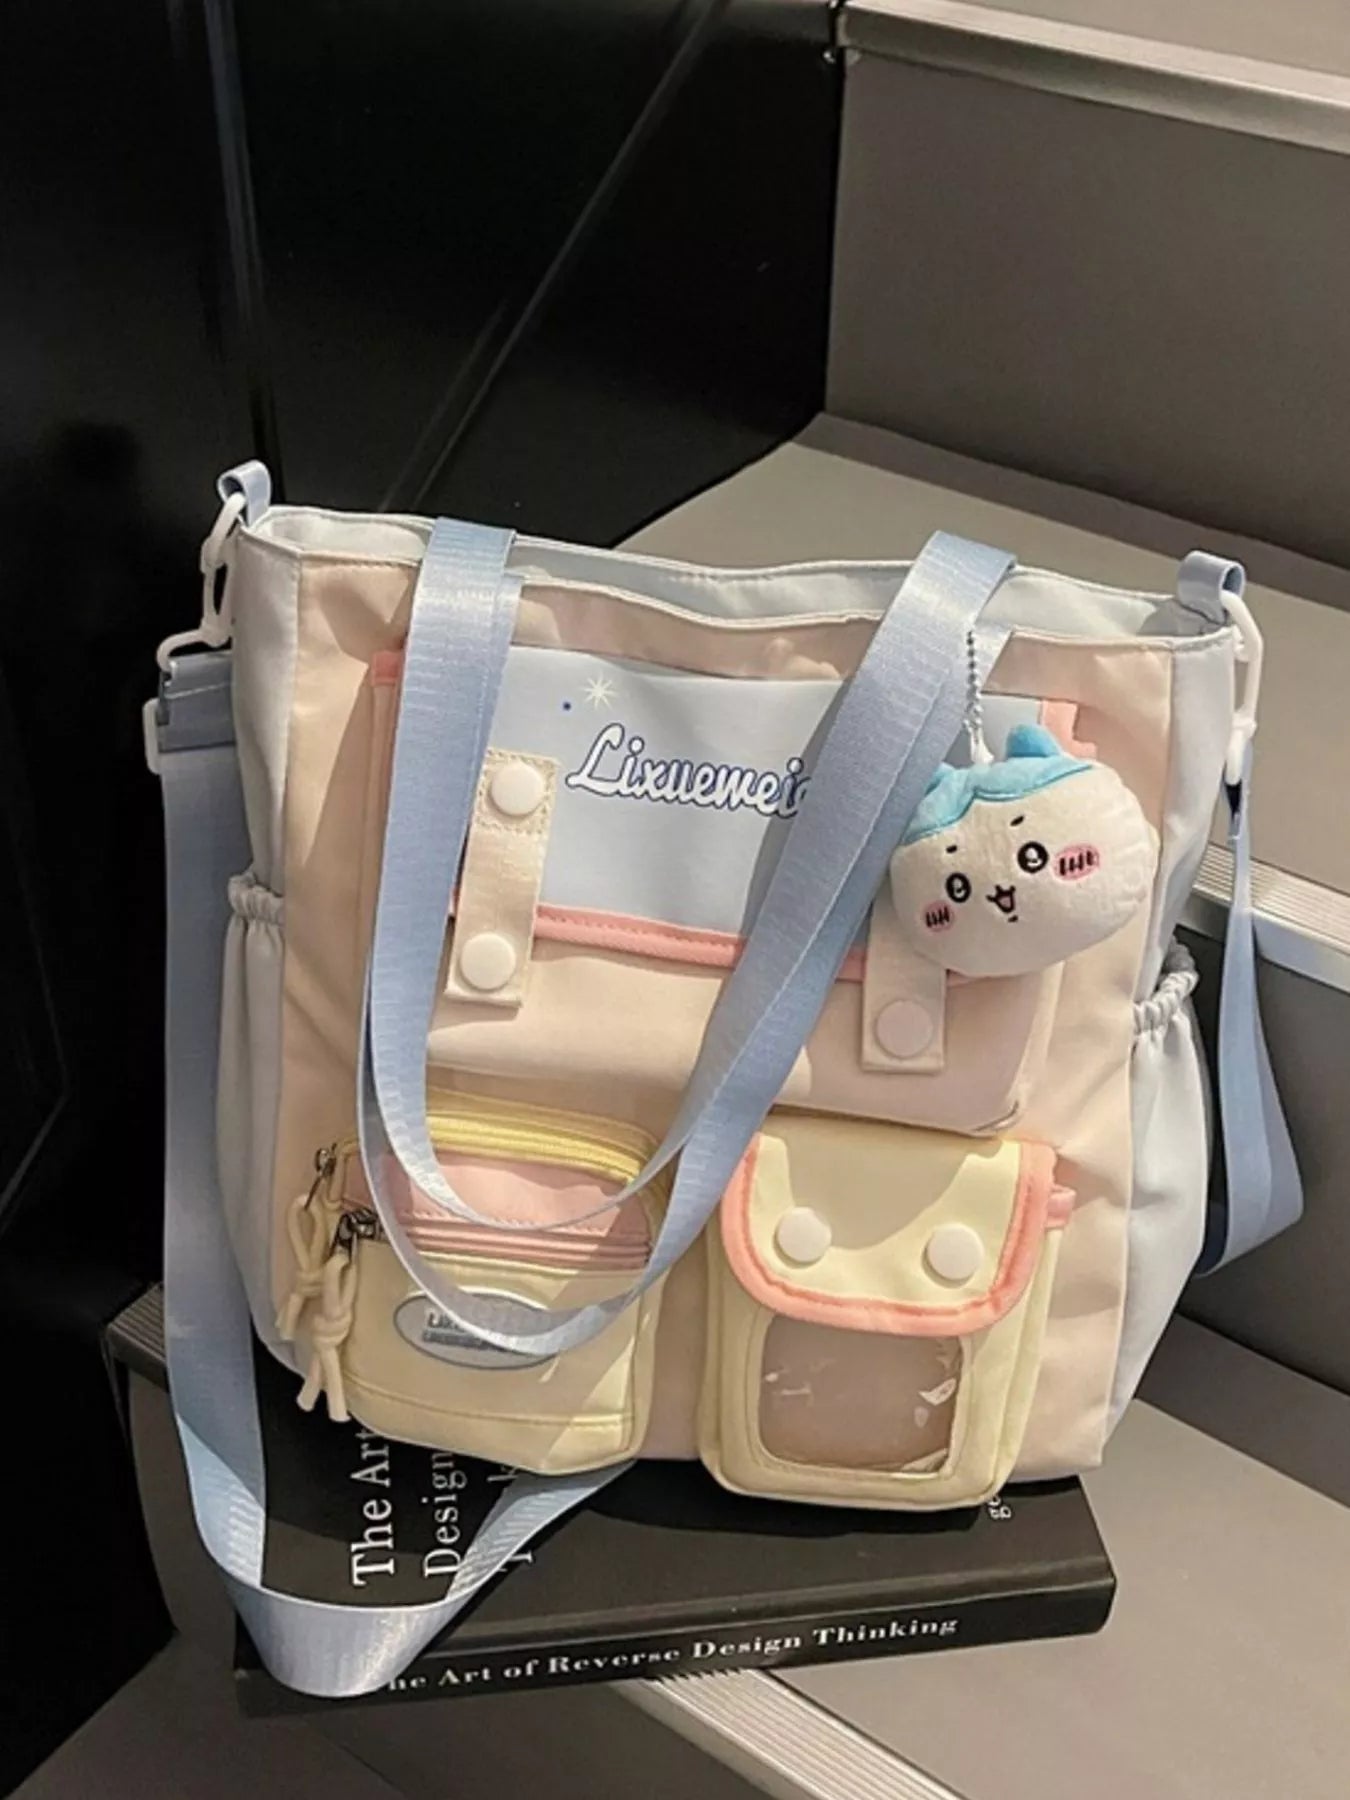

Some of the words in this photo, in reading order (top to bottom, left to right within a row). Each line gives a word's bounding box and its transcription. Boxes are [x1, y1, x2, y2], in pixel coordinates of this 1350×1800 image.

[566, 723, 812, 818] Lixuemei
[350, 1428, 391, 1487] Art
[350, 1499, 395, 1587] The
[421, 1452, 466, 1578] Design
[389, 1677, 427, 1691] he
[438, 1668, 492, 1687] Art
[503, 1658, 540, 1679] of
[548, 1649, 681, 1675] Reverse
[693, 1635, 801, 1659] Design
[812, 1618, 959, 1646] Thinking
